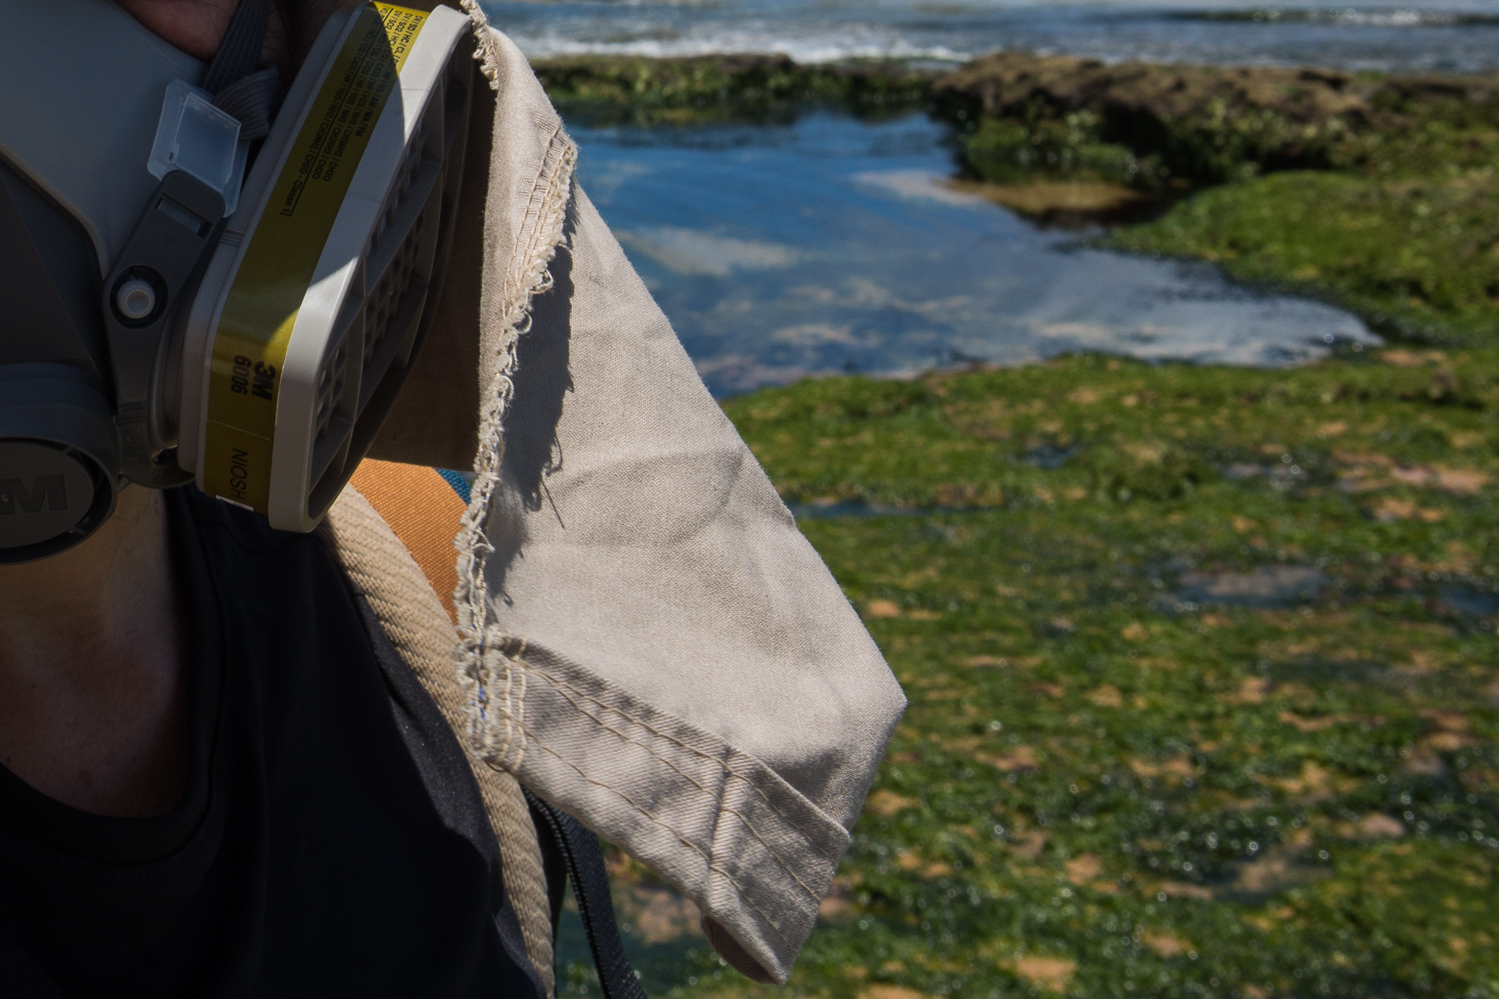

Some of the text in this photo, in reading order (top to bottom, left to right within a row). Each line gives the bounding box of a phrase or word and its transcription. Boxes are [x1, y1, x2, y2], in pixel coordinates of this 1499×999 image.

[385, 19, 397, 30] SO2
[395, 21, 407, 32] SO2
[400, 34, 411, 43] HC
[394, 46, 405, 54] CL
[343, 74, 352, 84] HF
[382, 70, 393, 81] HF
[355, 79, 365, 89] HF
[366, 81, 376, 91] HF
[375, 83, 387, 93] HS
[346, 92, 359, 105] H2S
[356, 94, 369, 108] H2S
[285, 180, 303, 206] Classe
[231, 355, 251, 395] 6006
[252, 361, 276, 401] 3M
[230, 448, 248, 500] NIOSH
